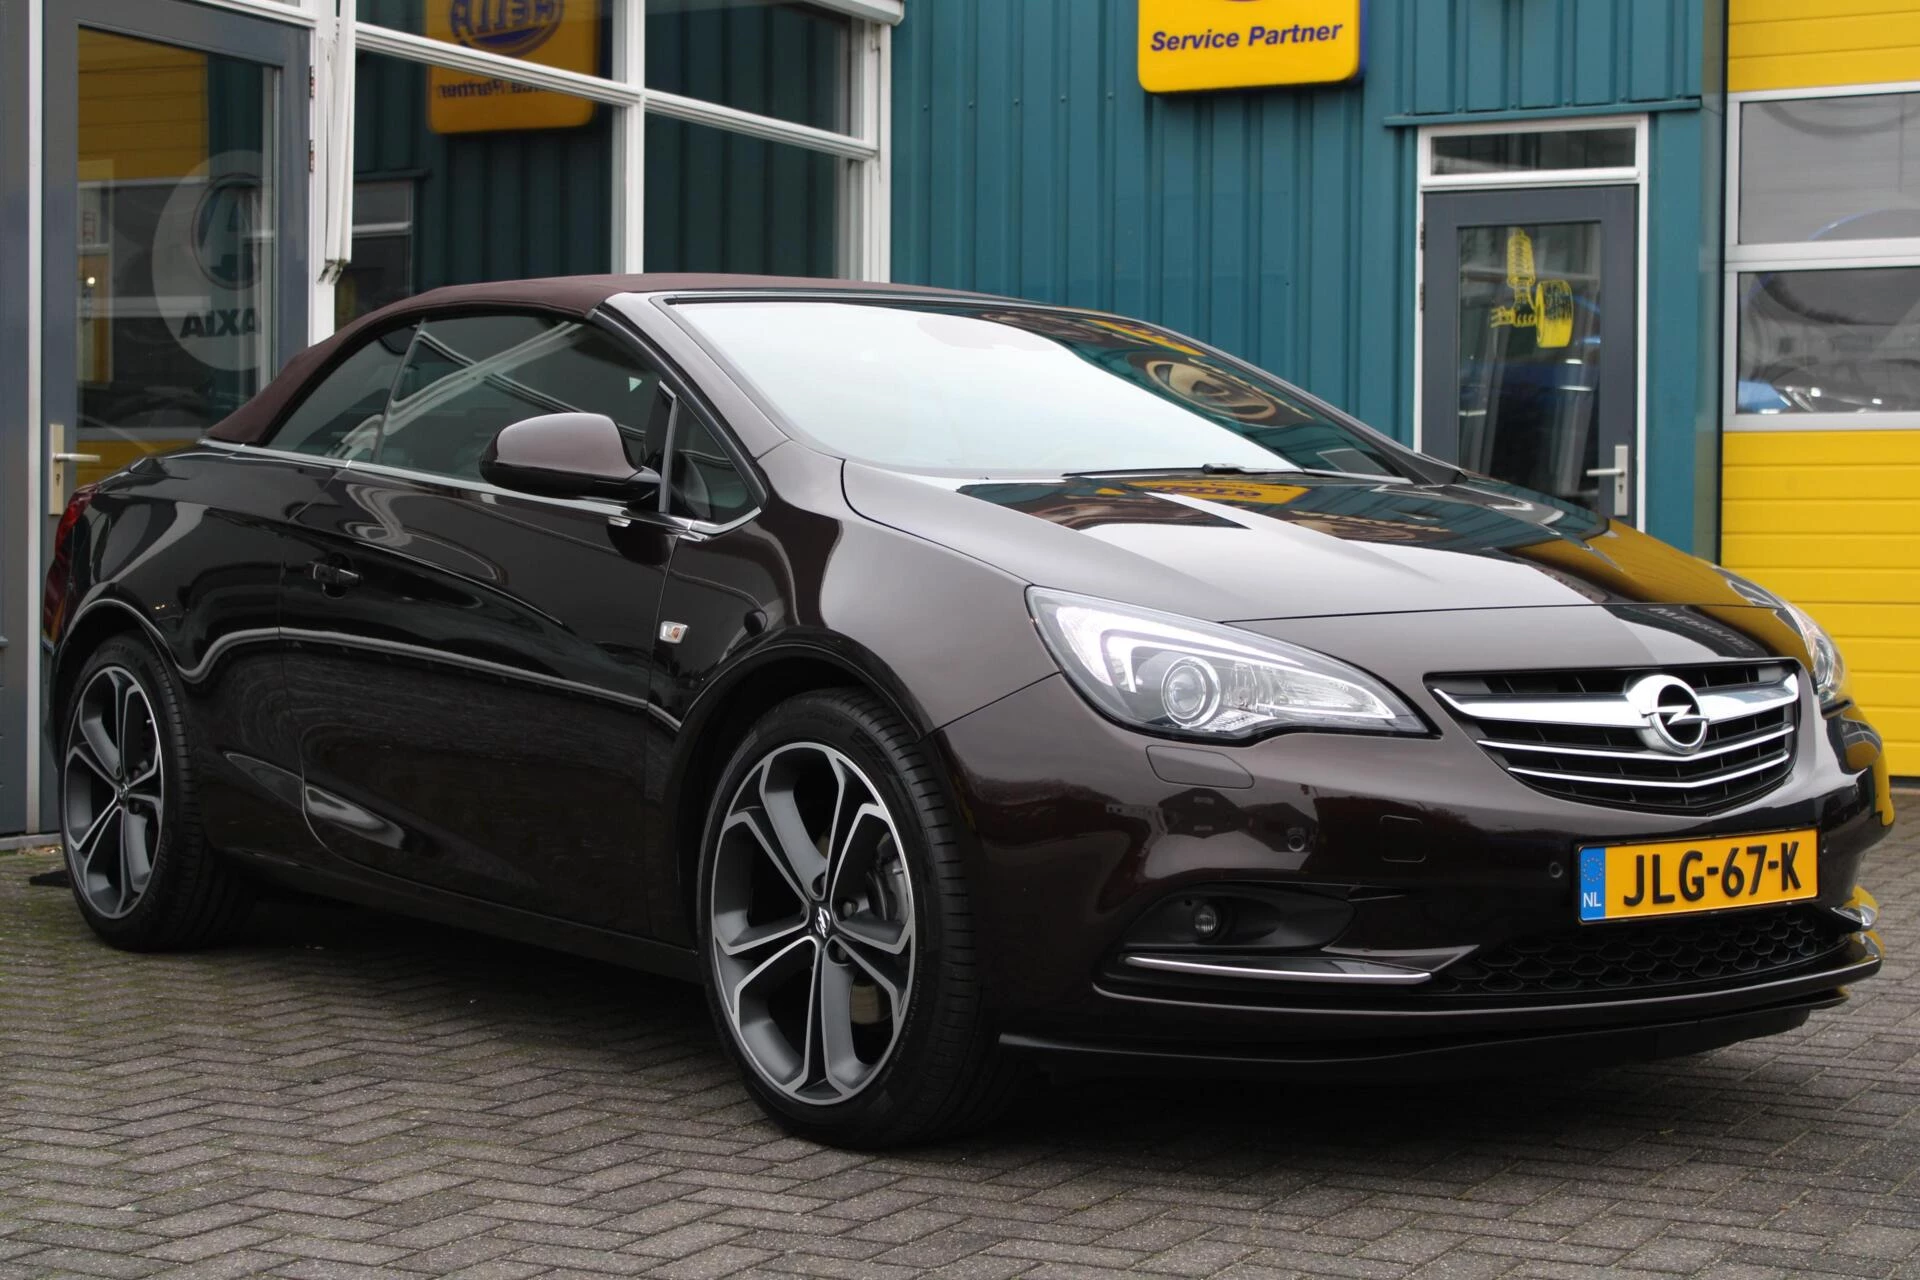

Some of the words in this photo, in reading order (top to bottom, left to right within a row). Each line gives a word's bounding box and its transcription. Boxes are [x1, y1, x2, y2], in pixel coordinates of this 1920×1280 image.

[1151, 30, 1240, 51] Service
[1248, 23, 1343, 46] Partner
[1623, 841, 1801, 907] JLG-67-K
[1583, 892, 1602, 908] NL
